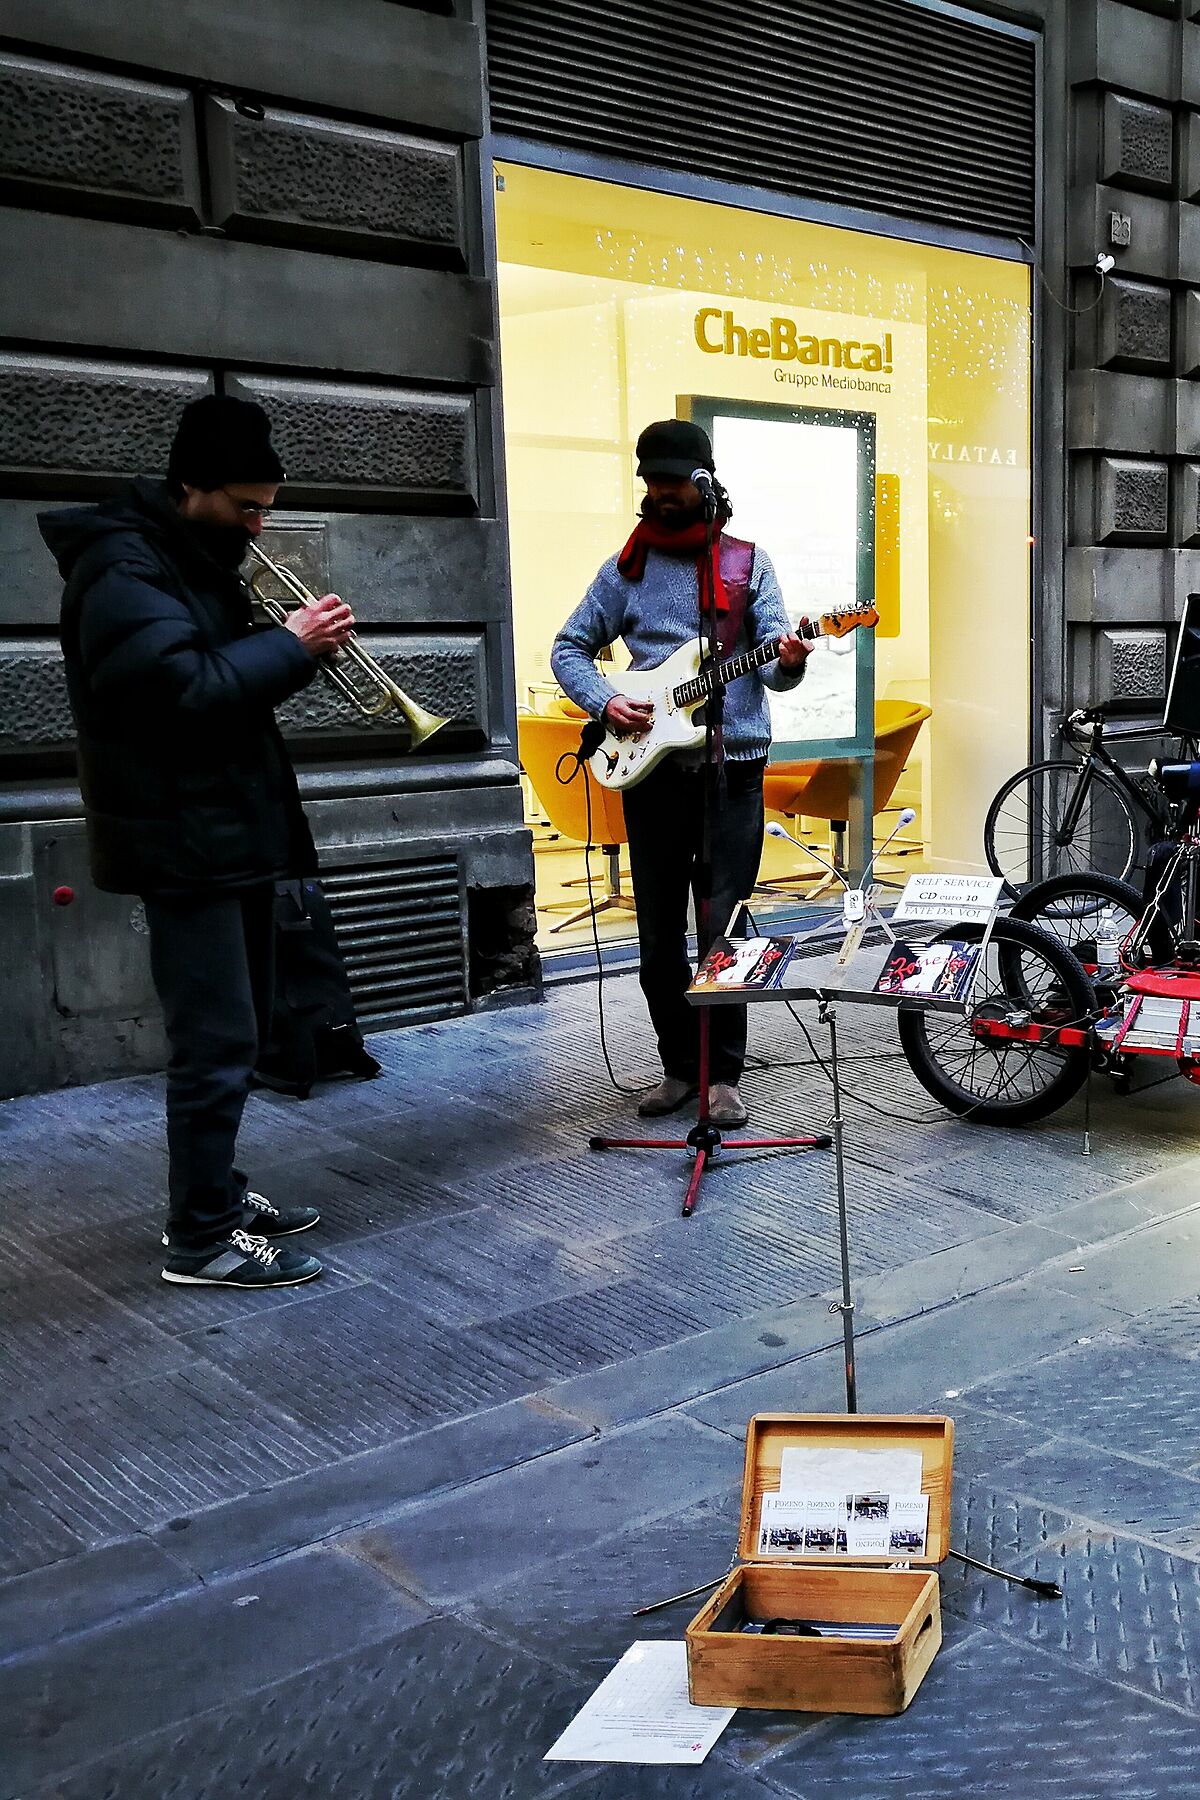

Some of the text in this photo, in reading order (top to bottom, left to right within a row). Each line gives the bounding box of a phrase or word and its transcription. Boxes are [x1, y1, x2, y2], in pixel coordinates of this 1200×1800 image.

[694, 307, 893, 374] CheBanca!
[774, 368, 892, 394] Gruppo Mediobanca
[915, 878, 994, 889] SELF SERVICE
[919, 892, 938, 900] CD
[904, 906, 981, 918] FATE DA VOI
